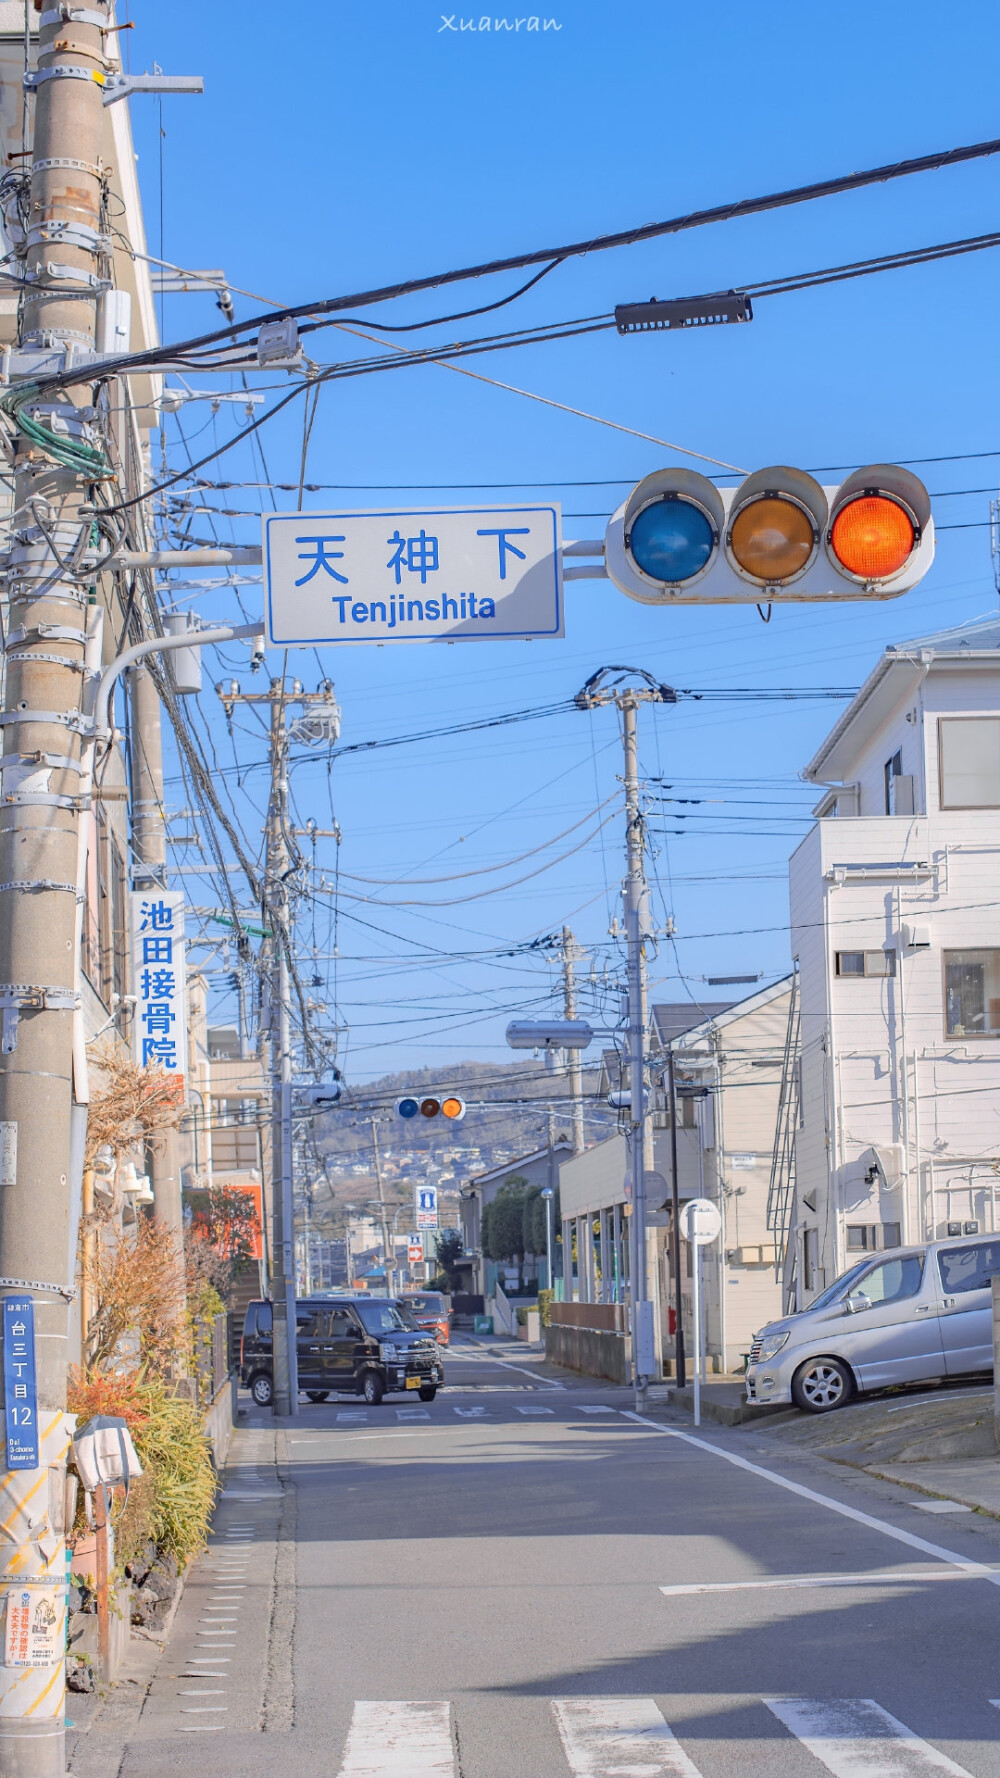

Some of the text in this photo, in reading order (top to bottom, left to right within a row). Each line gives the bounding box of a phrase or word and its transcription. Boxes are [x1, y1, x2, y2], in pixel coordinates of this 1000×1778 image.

[294, 527, 531, 588] 天神下
[331, 591, 496, 628] Tenjinshita
[140, 900, 177, 1069] 池田接骨院
[11, 1320, 28, 1398] 台三丁目
[11, 1406, 33, 1426] 12
